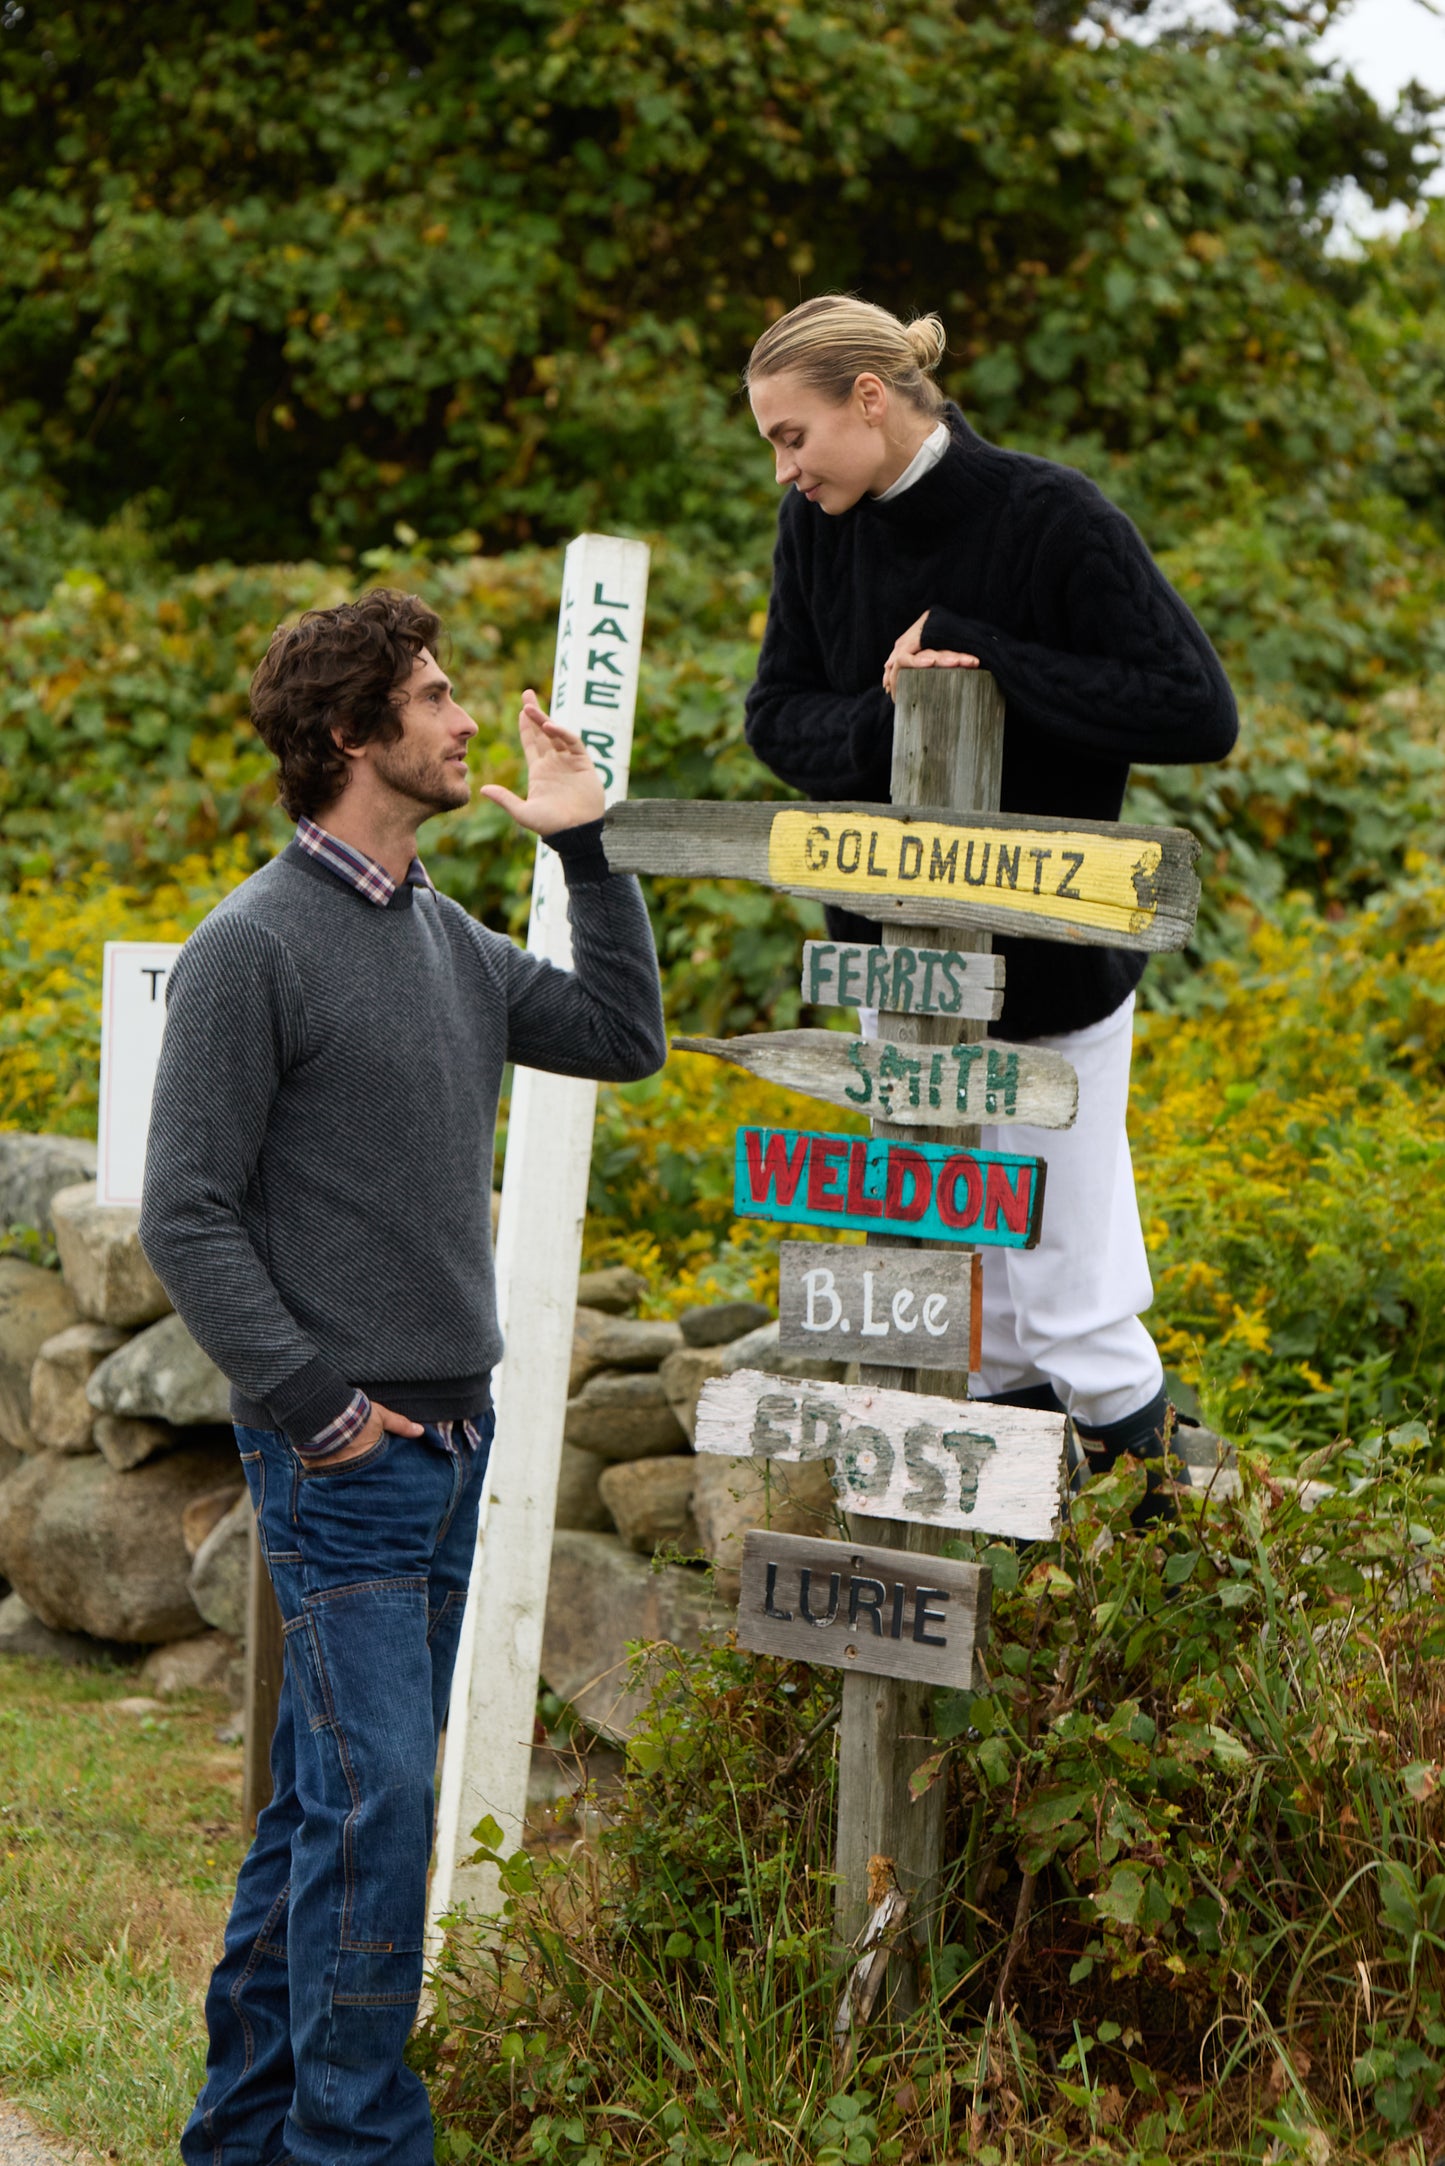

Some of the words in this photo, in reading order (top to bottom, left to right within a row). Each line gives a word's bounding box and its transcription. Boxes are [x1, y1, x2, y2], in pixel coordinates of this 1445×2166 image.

[555, 586, 574, 709] LAKE
[584, 583, 629, 709] LAKE
[805, 826, 1085, 899] GOLDMUNTZ
[809, 944, 967, 1013] FERRIS
[844, 1040, 1019, 1115] SMITH
[744, 1130, 1032, 1234] WELDON
[763, 1561, 951, 1647] LURIE
